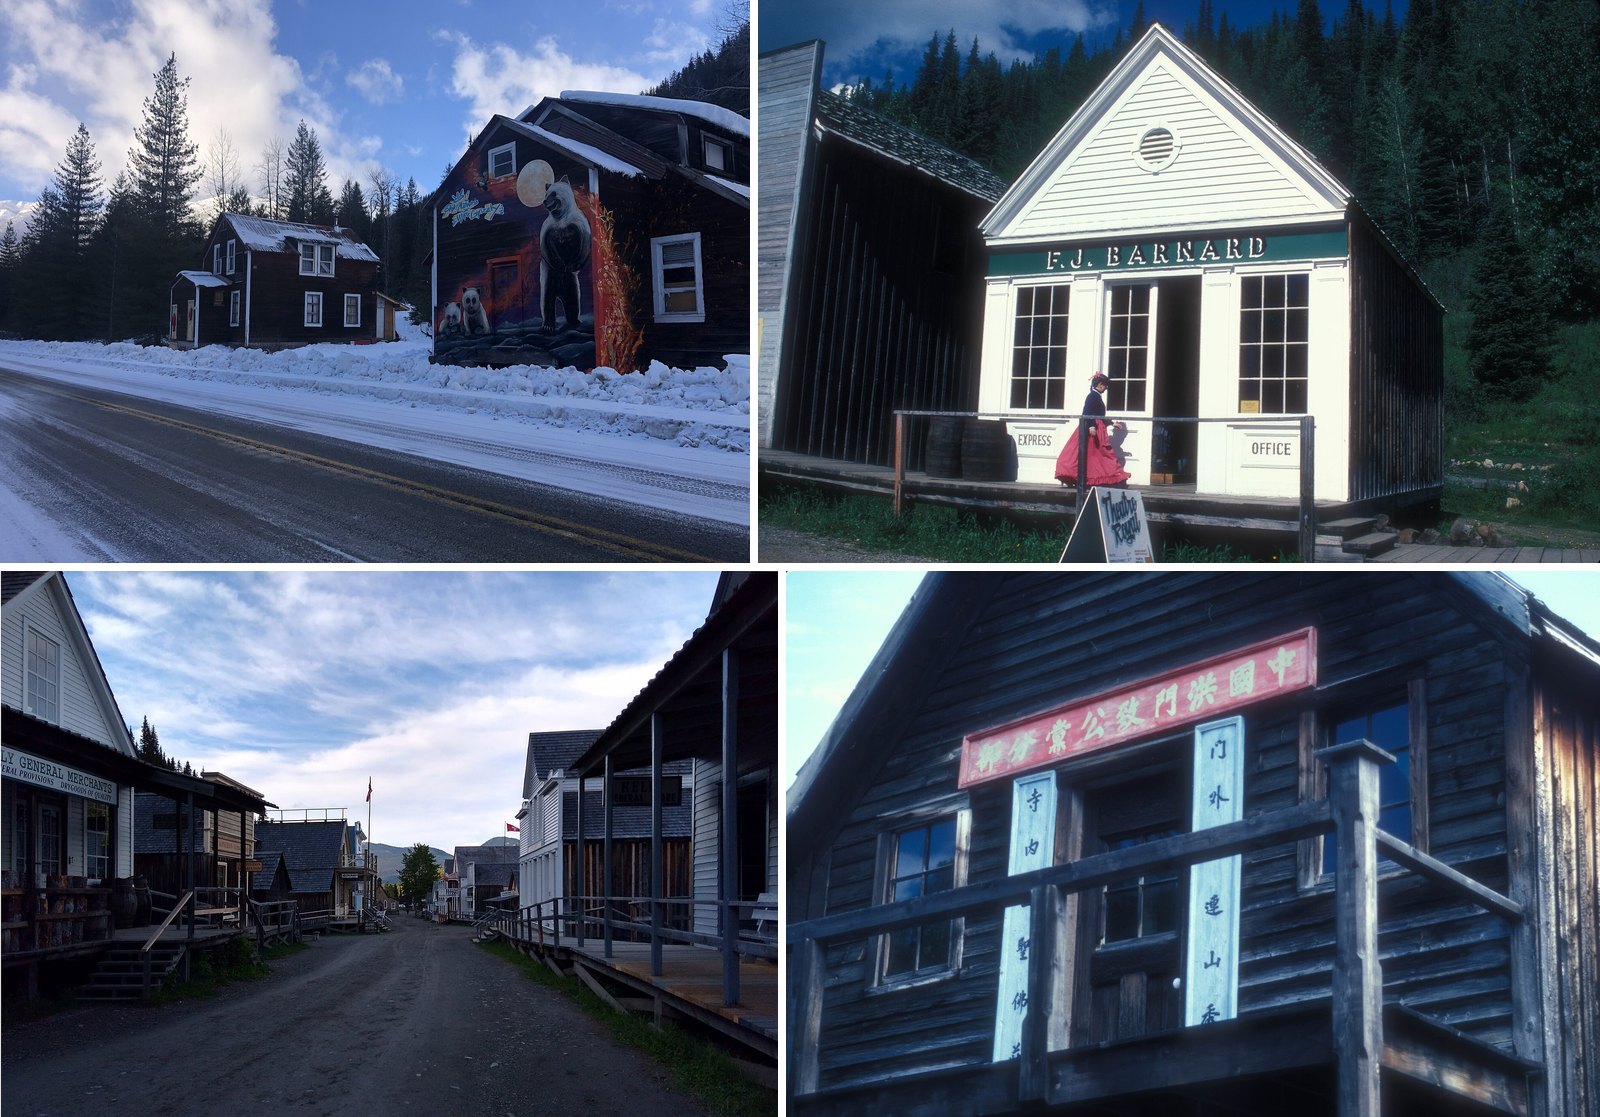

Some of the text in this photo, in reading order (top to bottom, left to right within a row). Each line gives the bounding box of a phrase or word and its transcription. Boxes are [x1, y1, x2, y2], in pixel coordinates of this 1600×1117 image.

[1046, 237, 1268, 270] F.J. BARNARD
[1017, 433, 1052, 447] EXPRESS
[1251, 441, 1292, 456] OFFICE
[1101, 490, 1138, 525] Theatre
[1111, 512, 1141, 547] Royal
[1, 764, 112, 802] ERAL PROVISIONS DRYGOODS OF QUALITY
[19, 756, 64, 779] GENERAL
[67, 770, 113, 794] MERCHANTS
